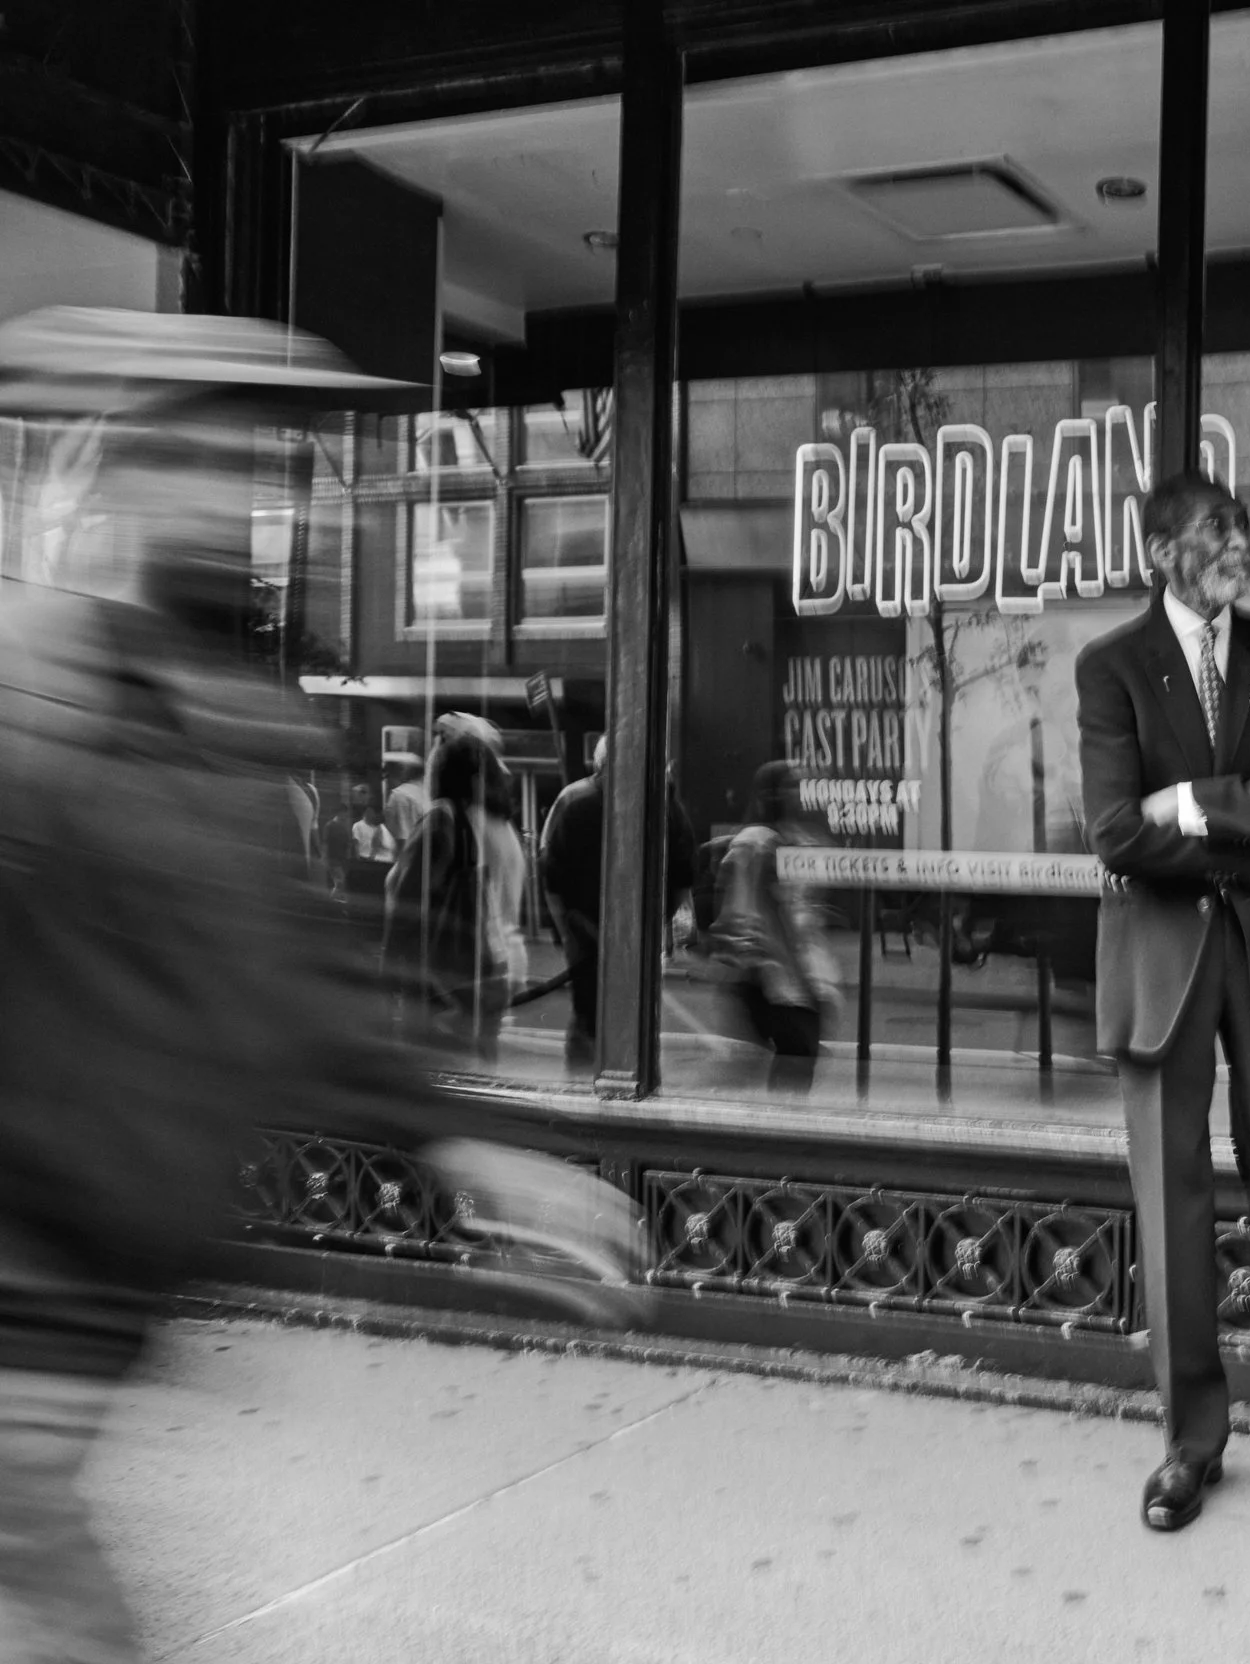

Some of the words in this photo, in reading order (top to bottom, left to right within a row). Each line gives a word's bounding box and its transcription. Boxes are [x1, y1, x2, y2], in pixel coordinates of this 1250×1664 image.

[783, 656, 822, 703] JIM
[784, 708, 847, 770] CAST
[851, 708, 932, 770] PARTY
[799, 778, 894, 809] MONDAYS
[896, 779, 922, 811] AT
[783, 854, 817, 875] FOR
[824, 855, 890, 878] TICKETS
[897, 856, 908, 878] &
[967, 859, 1011, 881] VISIT
